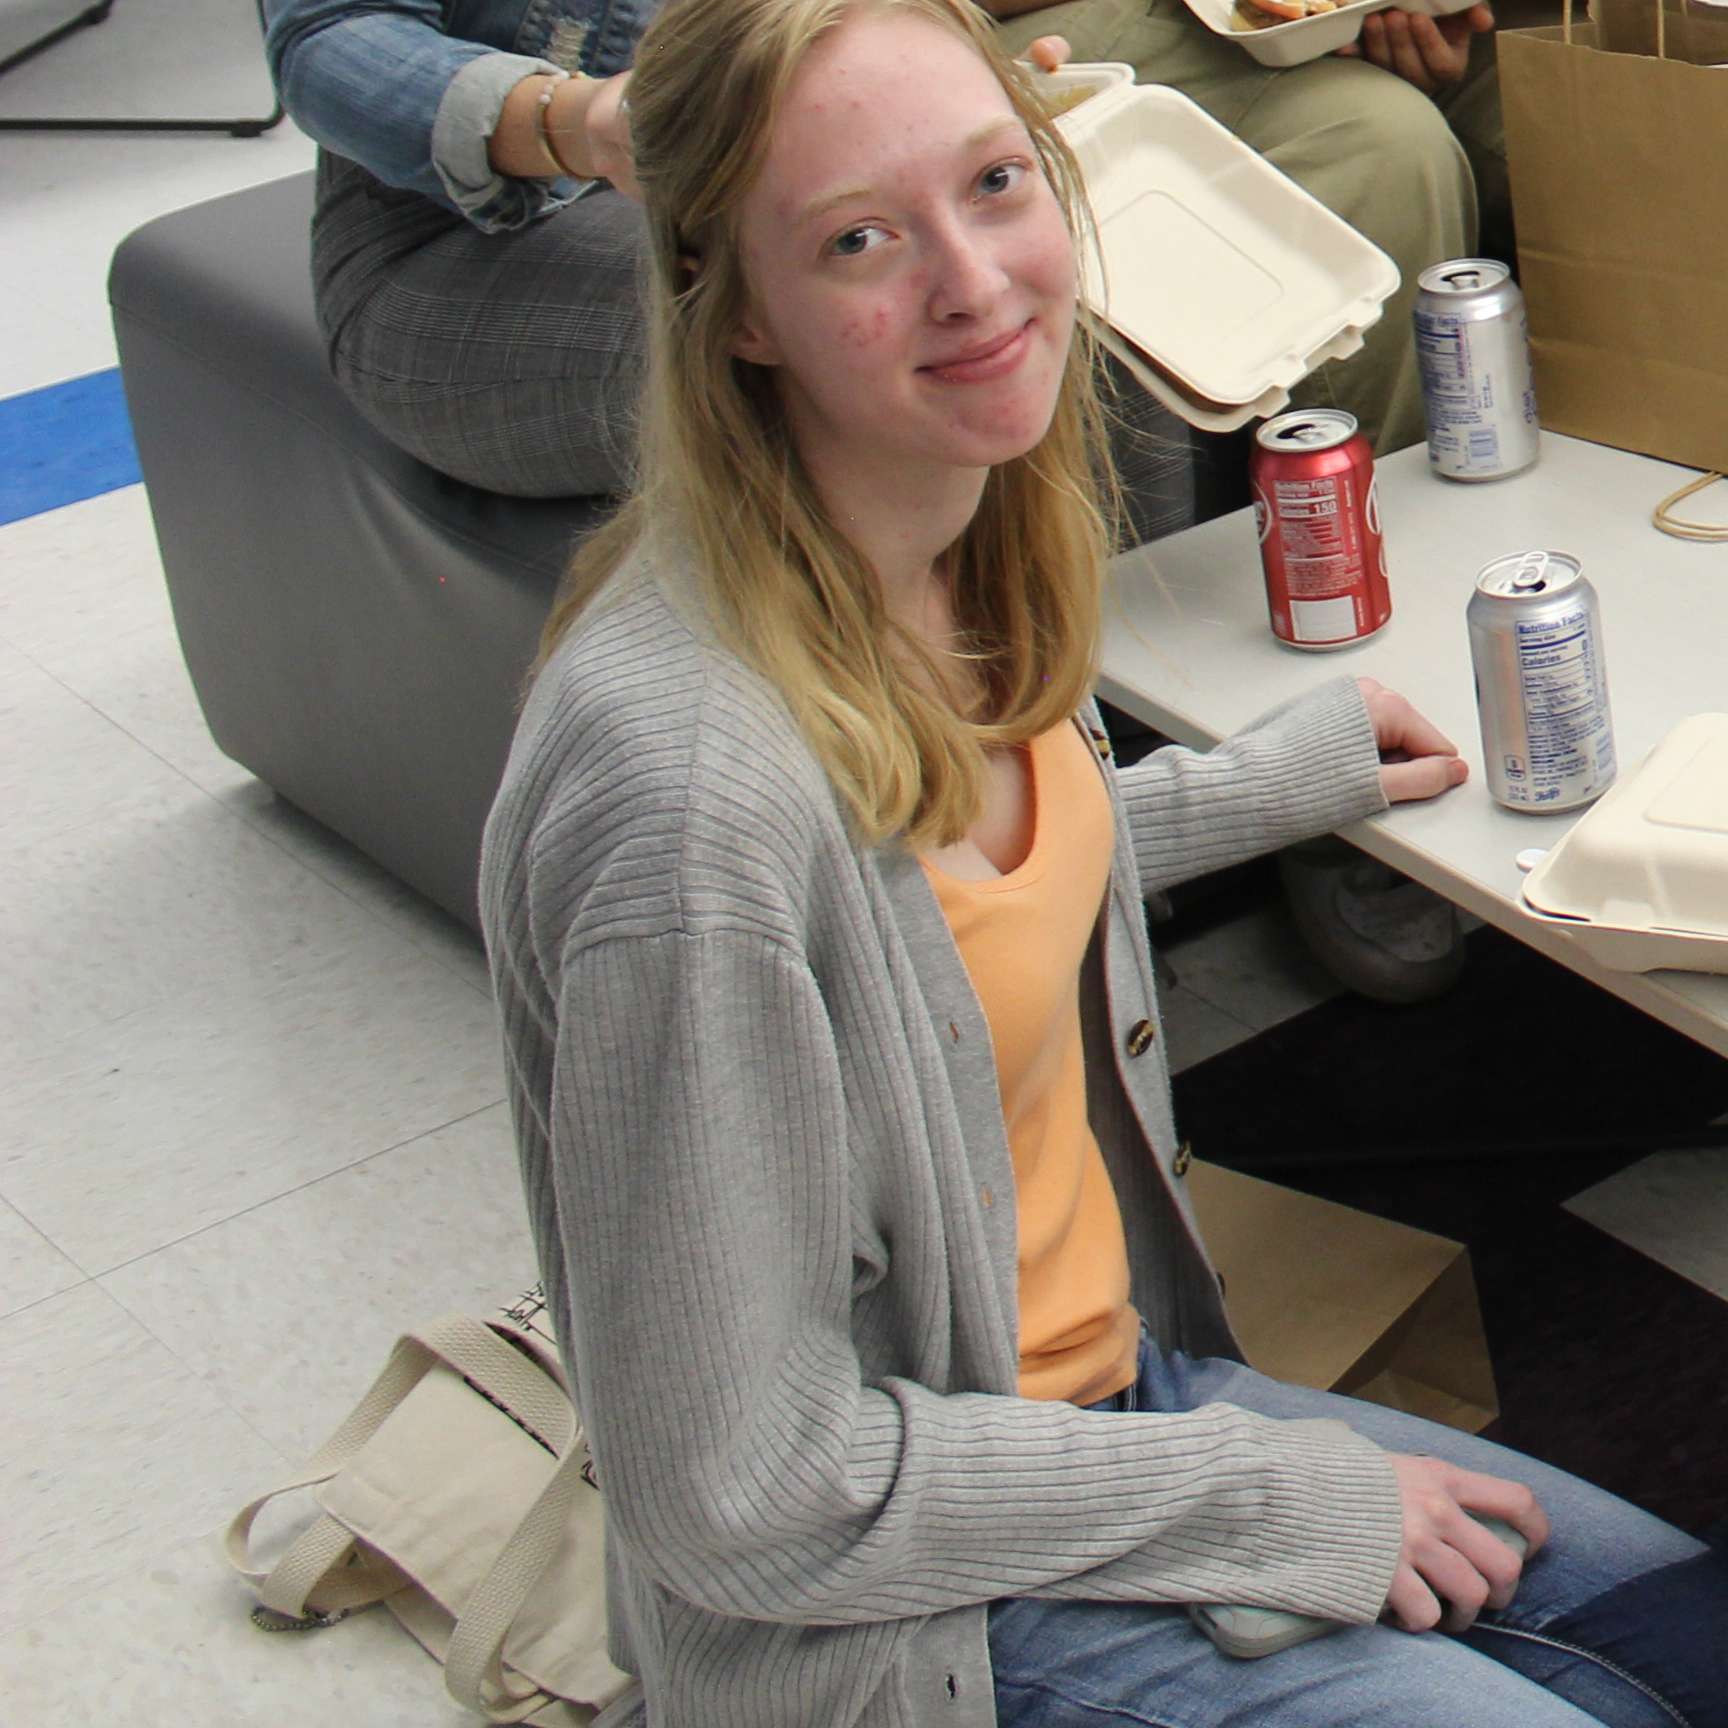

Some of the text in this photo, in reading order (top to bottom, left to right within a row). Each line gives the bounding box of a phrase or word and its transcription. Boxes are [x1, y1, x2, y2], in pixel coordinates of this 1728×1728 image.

[1313, 500, 1338, 514] 150
[1518, 621, 1561, 634] Nutrition
[1521, 655, 1561, 667] Calories
